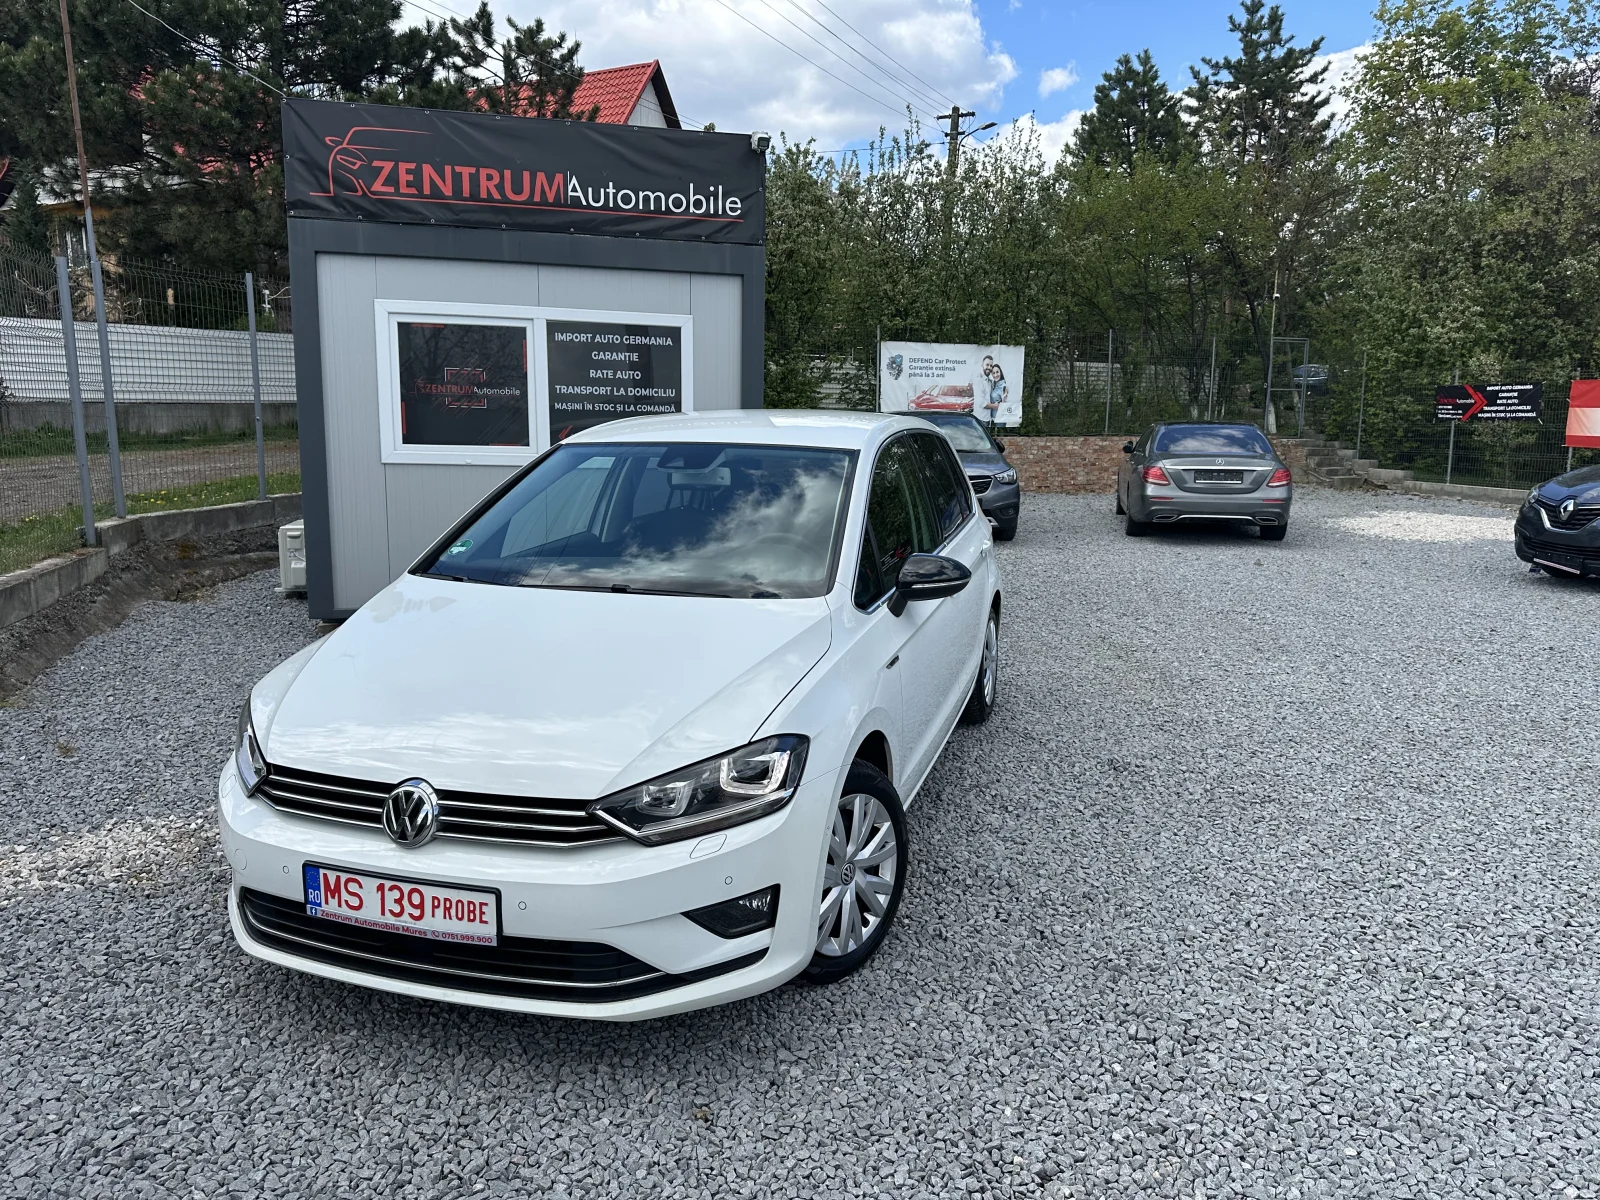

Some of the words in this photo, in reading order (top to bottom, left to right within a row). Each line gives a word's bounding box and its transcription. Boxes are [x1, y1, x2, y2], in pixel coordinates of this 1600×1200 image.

[370, 160, 564, 203] ZENTRUM
[568, 174, 742, 216] Automobile
[554, 332, 592, 343] IMPORT
[594, 334, 621, 344] AUTO
[622, 335, 673, 346] GERMANIA
[591, 351, 639, 363] GARANȚIE
[909, 364, 934, 372] Garanție
[589, 369, 614, 379] RATE
[616, 370, 641, 380] AUTO
[425, 384, 473, 394] ZENTRUM
[473, 386, 520, 396] Automobile
[555, 385, 611, 395] TRANSPORT
[613, 386, 626, 396] LA
[627, 387, 676, 397] DOMICILIU
[554, 402, 583, 412] MAȘINI
[584, 401, 593, 410] ÎN
[594, 403, 615, 411] STOC
[616, 403, 623, 413] ȘI
[625, 404, 635, 412] LA
[636, 403, 676, 413] COMANDĂ
[308, 889, 320, 903] RO
[322, 872, 364, 911] MS
[376, 882, 425, 921] 139
[431, 895, 489, 925] PROBE
[320, 909, 353, 925] Zentrum
[354, 916, 401, 932] Automobile
[401, 925, 428, 938] Mures
[441, 931, 493, 945] 0751.999.900
